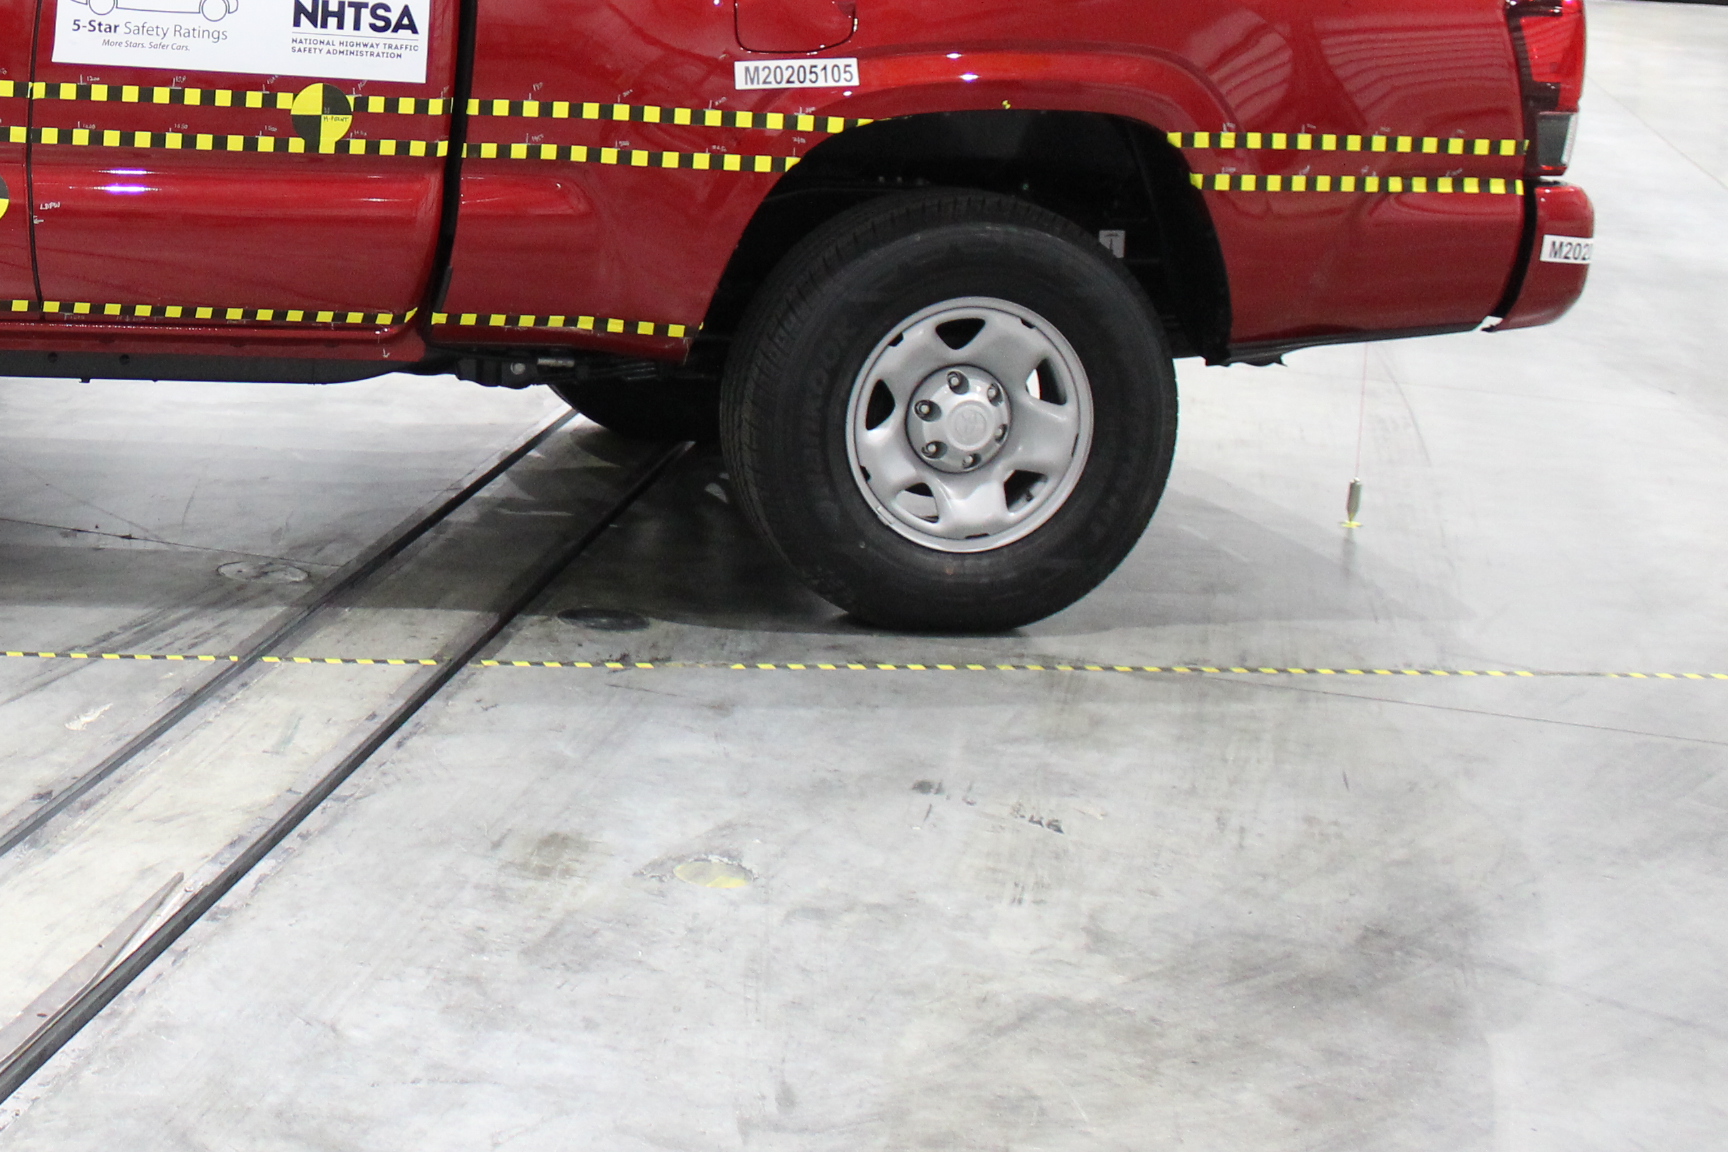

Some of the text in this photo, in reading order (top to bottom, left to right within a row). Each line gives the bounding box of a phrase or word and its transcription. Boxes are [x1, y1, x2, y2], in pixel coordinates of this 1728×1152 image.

[71, 18, 228, 42] 5-Star Safety Ratings
[101, 38, 191, 52] More Stars. Safer Cars.
[290, 46, 403, 59] SAFETY ADMINISTRATION
[291, 37, 419, 52] NATIONAL HIGHWAY TRAFFIC
[744, 63, 853, 86] M20205105
[1549, 240, 1592, 261] M202
